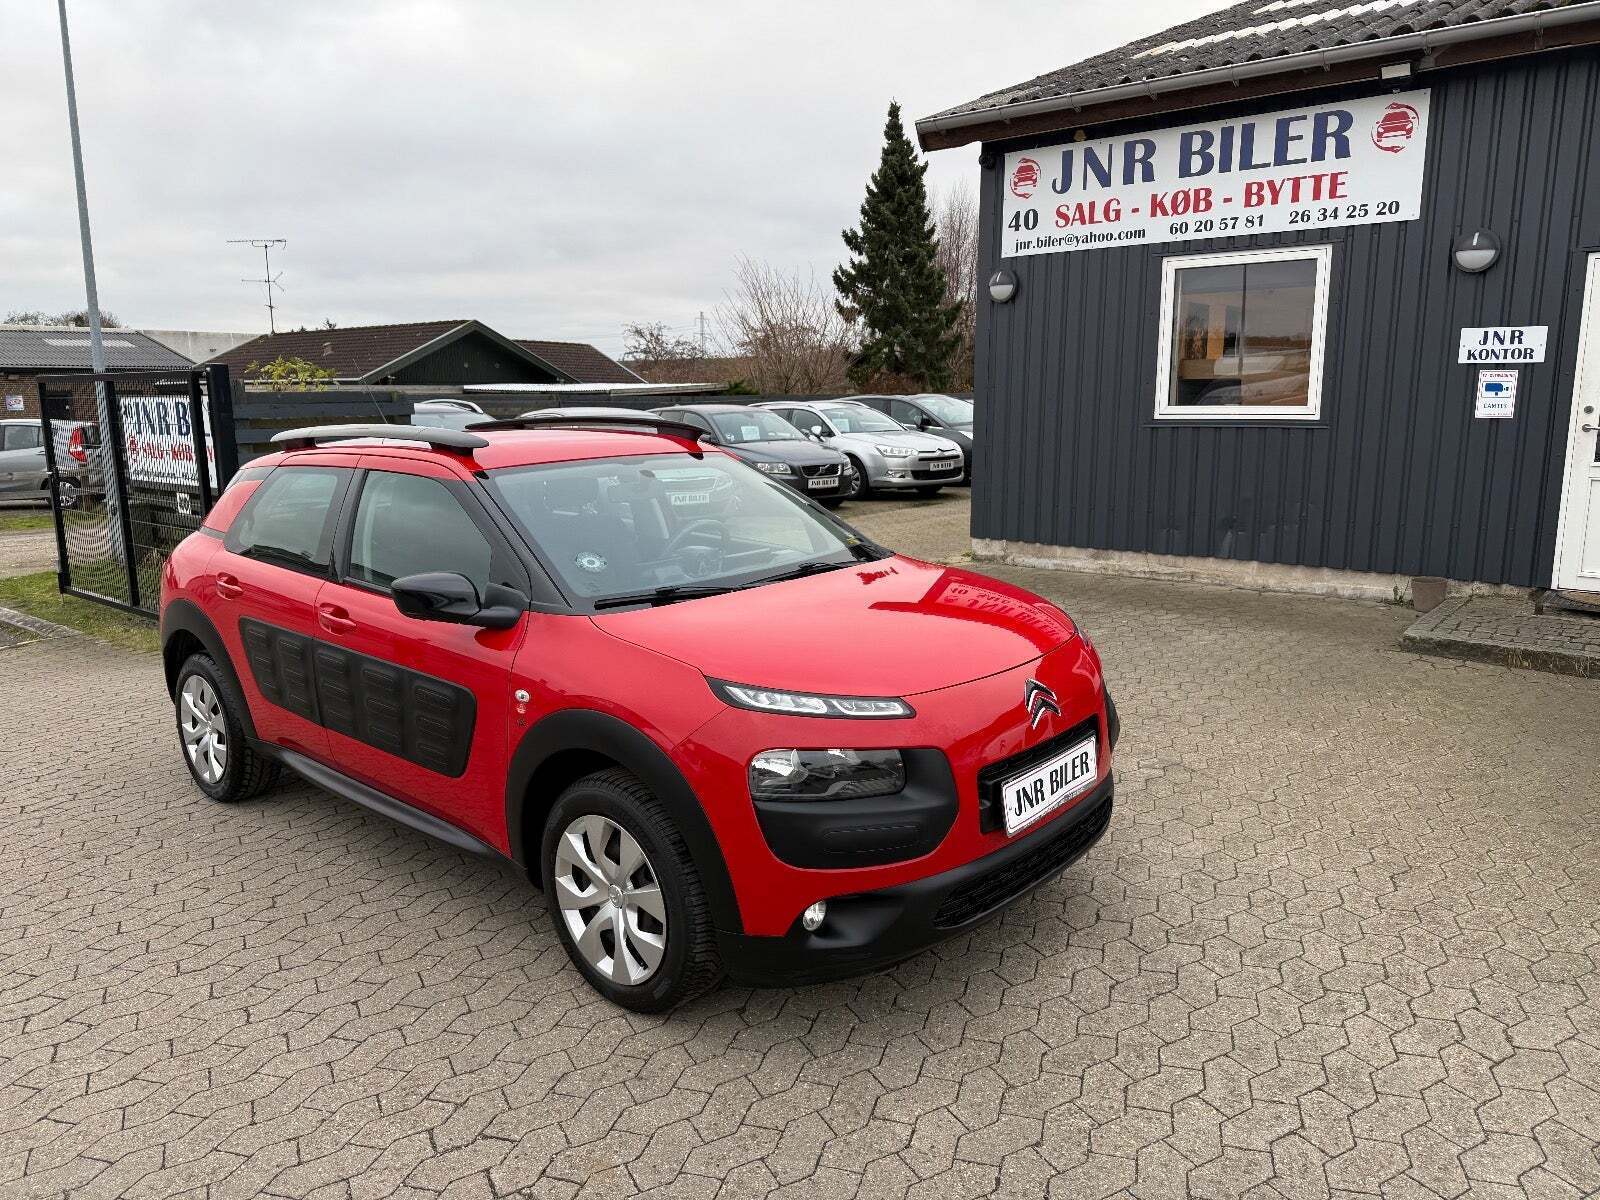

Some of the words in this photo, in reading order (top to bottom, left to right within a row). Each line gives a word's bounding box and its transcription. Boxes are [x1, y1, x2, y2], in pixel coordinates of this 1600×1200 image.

[1051, 138, 1157, 195] JNR
[1178, 109, 1354, 179] BILER
[1054, 197, 1122, 229] SALG
[1149, 187, 1213, 218] KØB
[1243, 171, 1349, 208] BYTTE
[1288, 209, 1311, 225] 26
[1317, 206, 1339, 222] 34
[1346, 203, 1369, 219] 25
[1375, 200, 1400, 216] 20
[1008, 208, 1039, 232] 40
[1169, 221, 1189, 236] 60
[1193, 218, 1214, 234] 20
[1218, 216, 1239, 231] 57
[1244, 213, 1264, 229] 81
[1015, 228, 1146, 253] jnr.biler@yahoo.com
[1478, 329, 1524, 346] JNR
[1466, 347, 1535, 361] KONTOR
[1014, 778, 1046, 817] JNR
[1049, 751, 1090, 796] BILER
